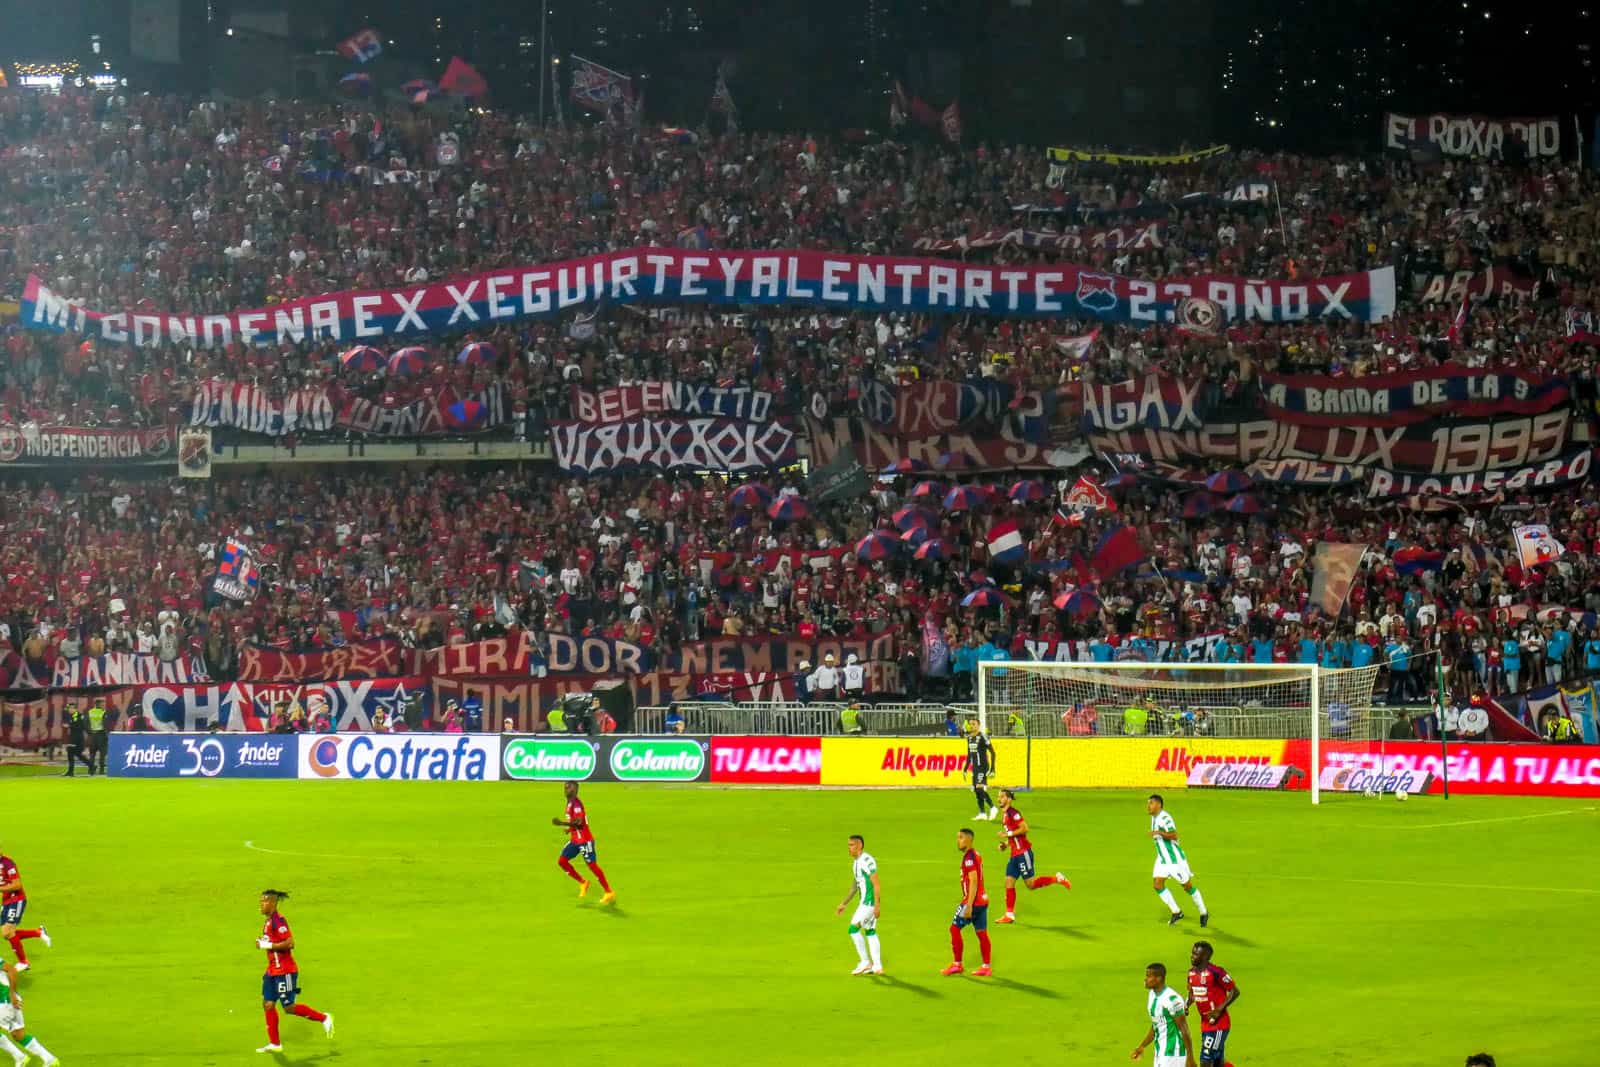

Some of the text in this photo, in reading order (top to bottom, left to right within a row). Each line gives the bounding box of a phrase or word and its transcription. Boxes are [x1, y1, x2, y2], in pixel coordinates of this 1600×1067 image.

[1305, 388, 1390, 413] BANDA
[1413, 379, 1448, 405] DE
[1467, 375, 1499, 399] LA
[26, 433, 142, 458] INDEPENDENCIA
[179, 738, 225, 776] 30
[347, 736, 486, 780] Cotrafa
[507, 744, 592, 772] Colanta
[613, 744, 700, 772] Colanta
[714, 748, 744, 772] TU
[881, 748, 972, 776] Alkompr
[1486, 756, 1506, 783] A
[1513, 757, 1547, 785] TU
[1214, 764, 1274, 784] Cotrafa
[1349, 770, 1414, 791] Cotrafa
